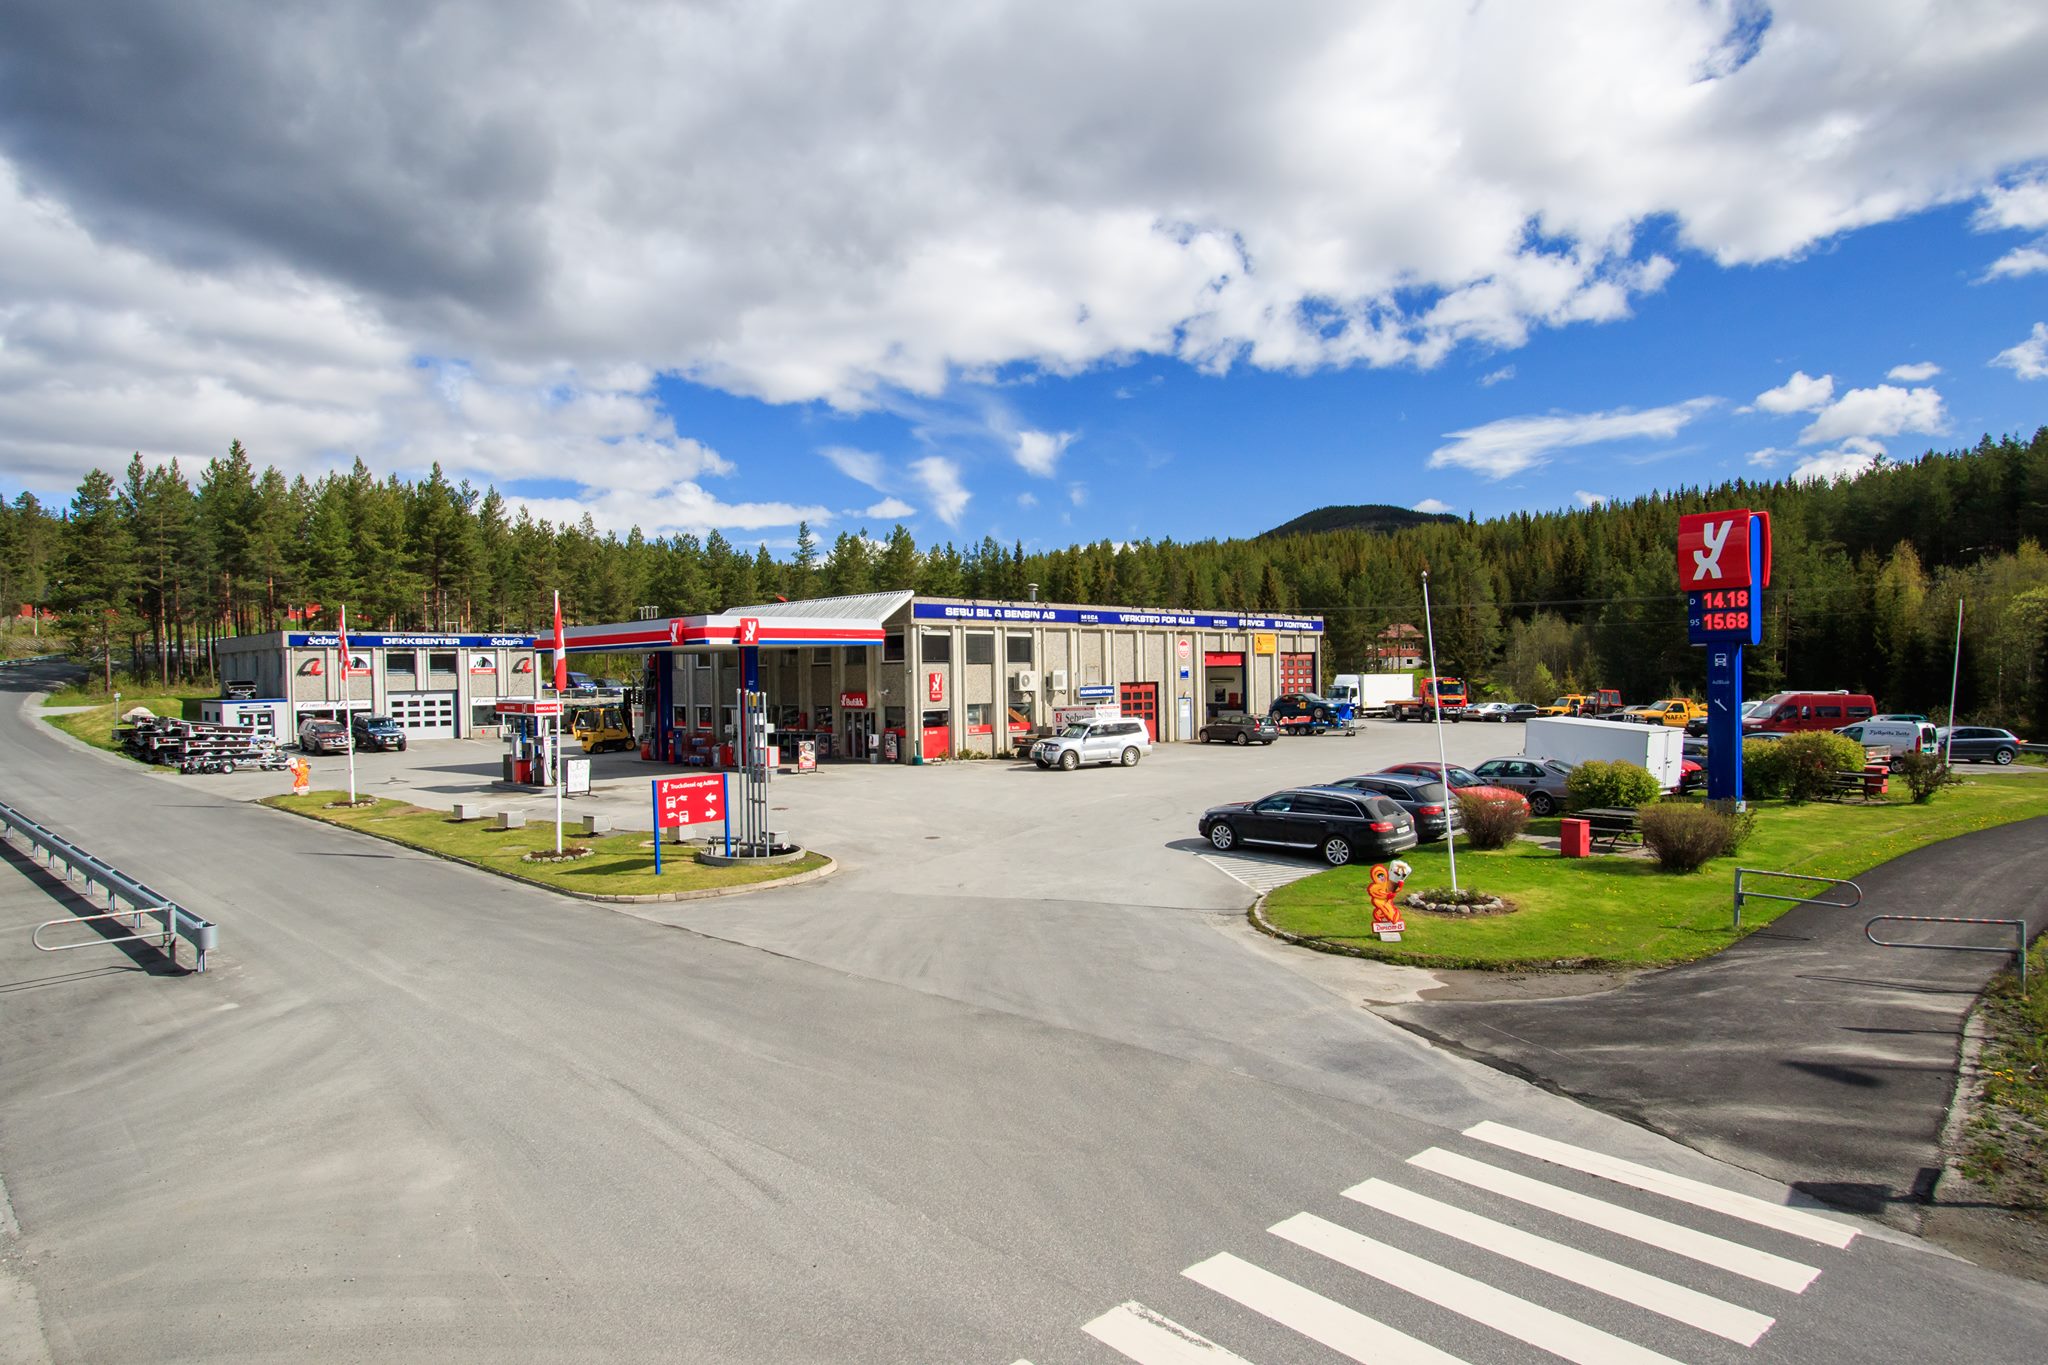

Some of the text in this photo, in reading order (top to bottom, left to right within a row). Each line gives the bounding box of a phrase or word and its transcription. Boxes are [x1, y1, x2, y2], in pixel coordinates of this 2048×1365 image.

[1703, 590, 1749, 609] 14.18
[945, 607, 1055, 620] SEBU BIL & BENSIN AS
[1119, 614, 1195, 624] VERKSTED FOR ALLE
[1690, 612, 1749, 630] 95 15.68
[1284, 621, 1313, 629] KONTROLL
[308, 636, 334, 645] Sebu
[382, 637, 460, 645] DEKKSENTER
[491, 637, 513, 646] Sebu
